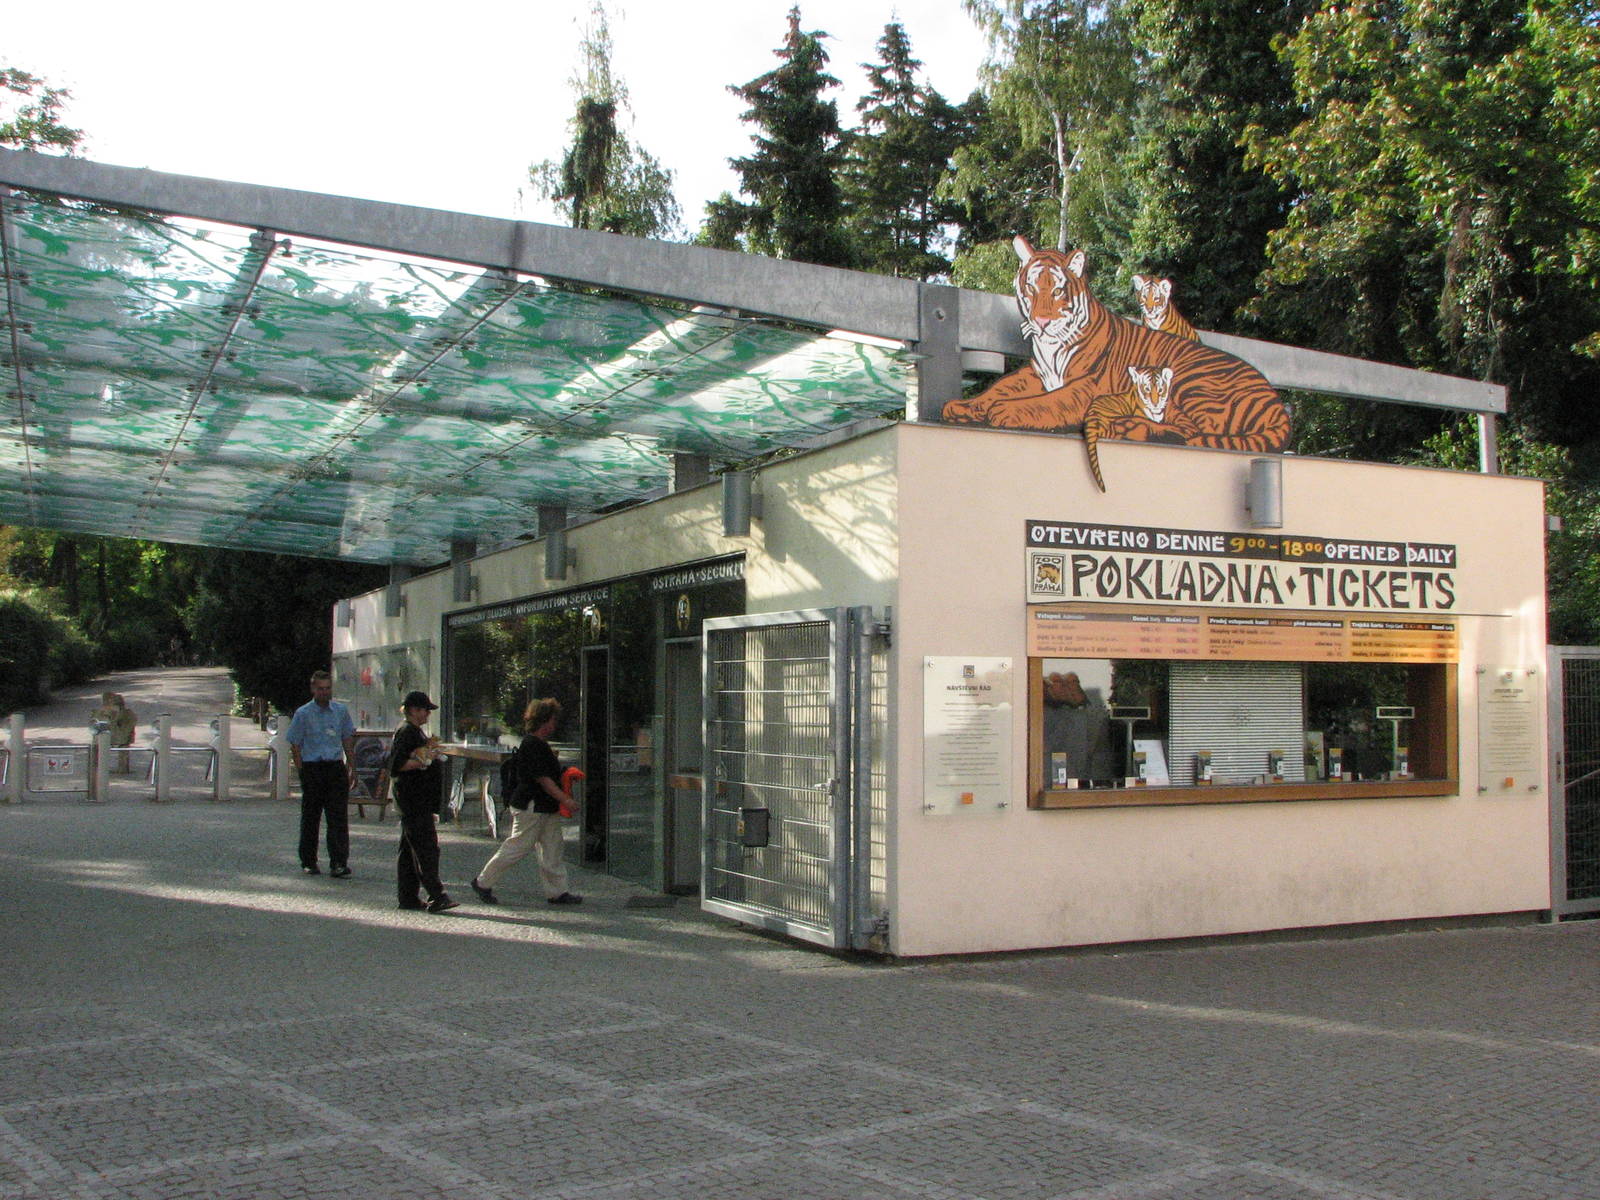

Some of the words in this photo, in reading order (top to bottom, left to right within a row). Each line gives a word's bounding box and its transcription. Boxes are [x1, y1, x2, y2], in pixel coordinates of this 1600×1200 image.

[1031, 525, 1149, 547] OTEVŘENO
[1156, 532, 1225, 552] DENNĚ
[1324, 541, 1400, 562] OPENED
[1406, 546, 1454, 564] DAILY
[1035, 557, 1061, 565] ZOO
[652, 570, 696, 590] OSTRAHA
[1034, 582, 1061, 592] PRAHA
[1072, 554, 1284, 603] POKLADNA
[1299, 566, 1456, 610] TICKETS
[516, 595, 568, 615] INFORMATION
[570, 586, 609, 605] SERVICE
